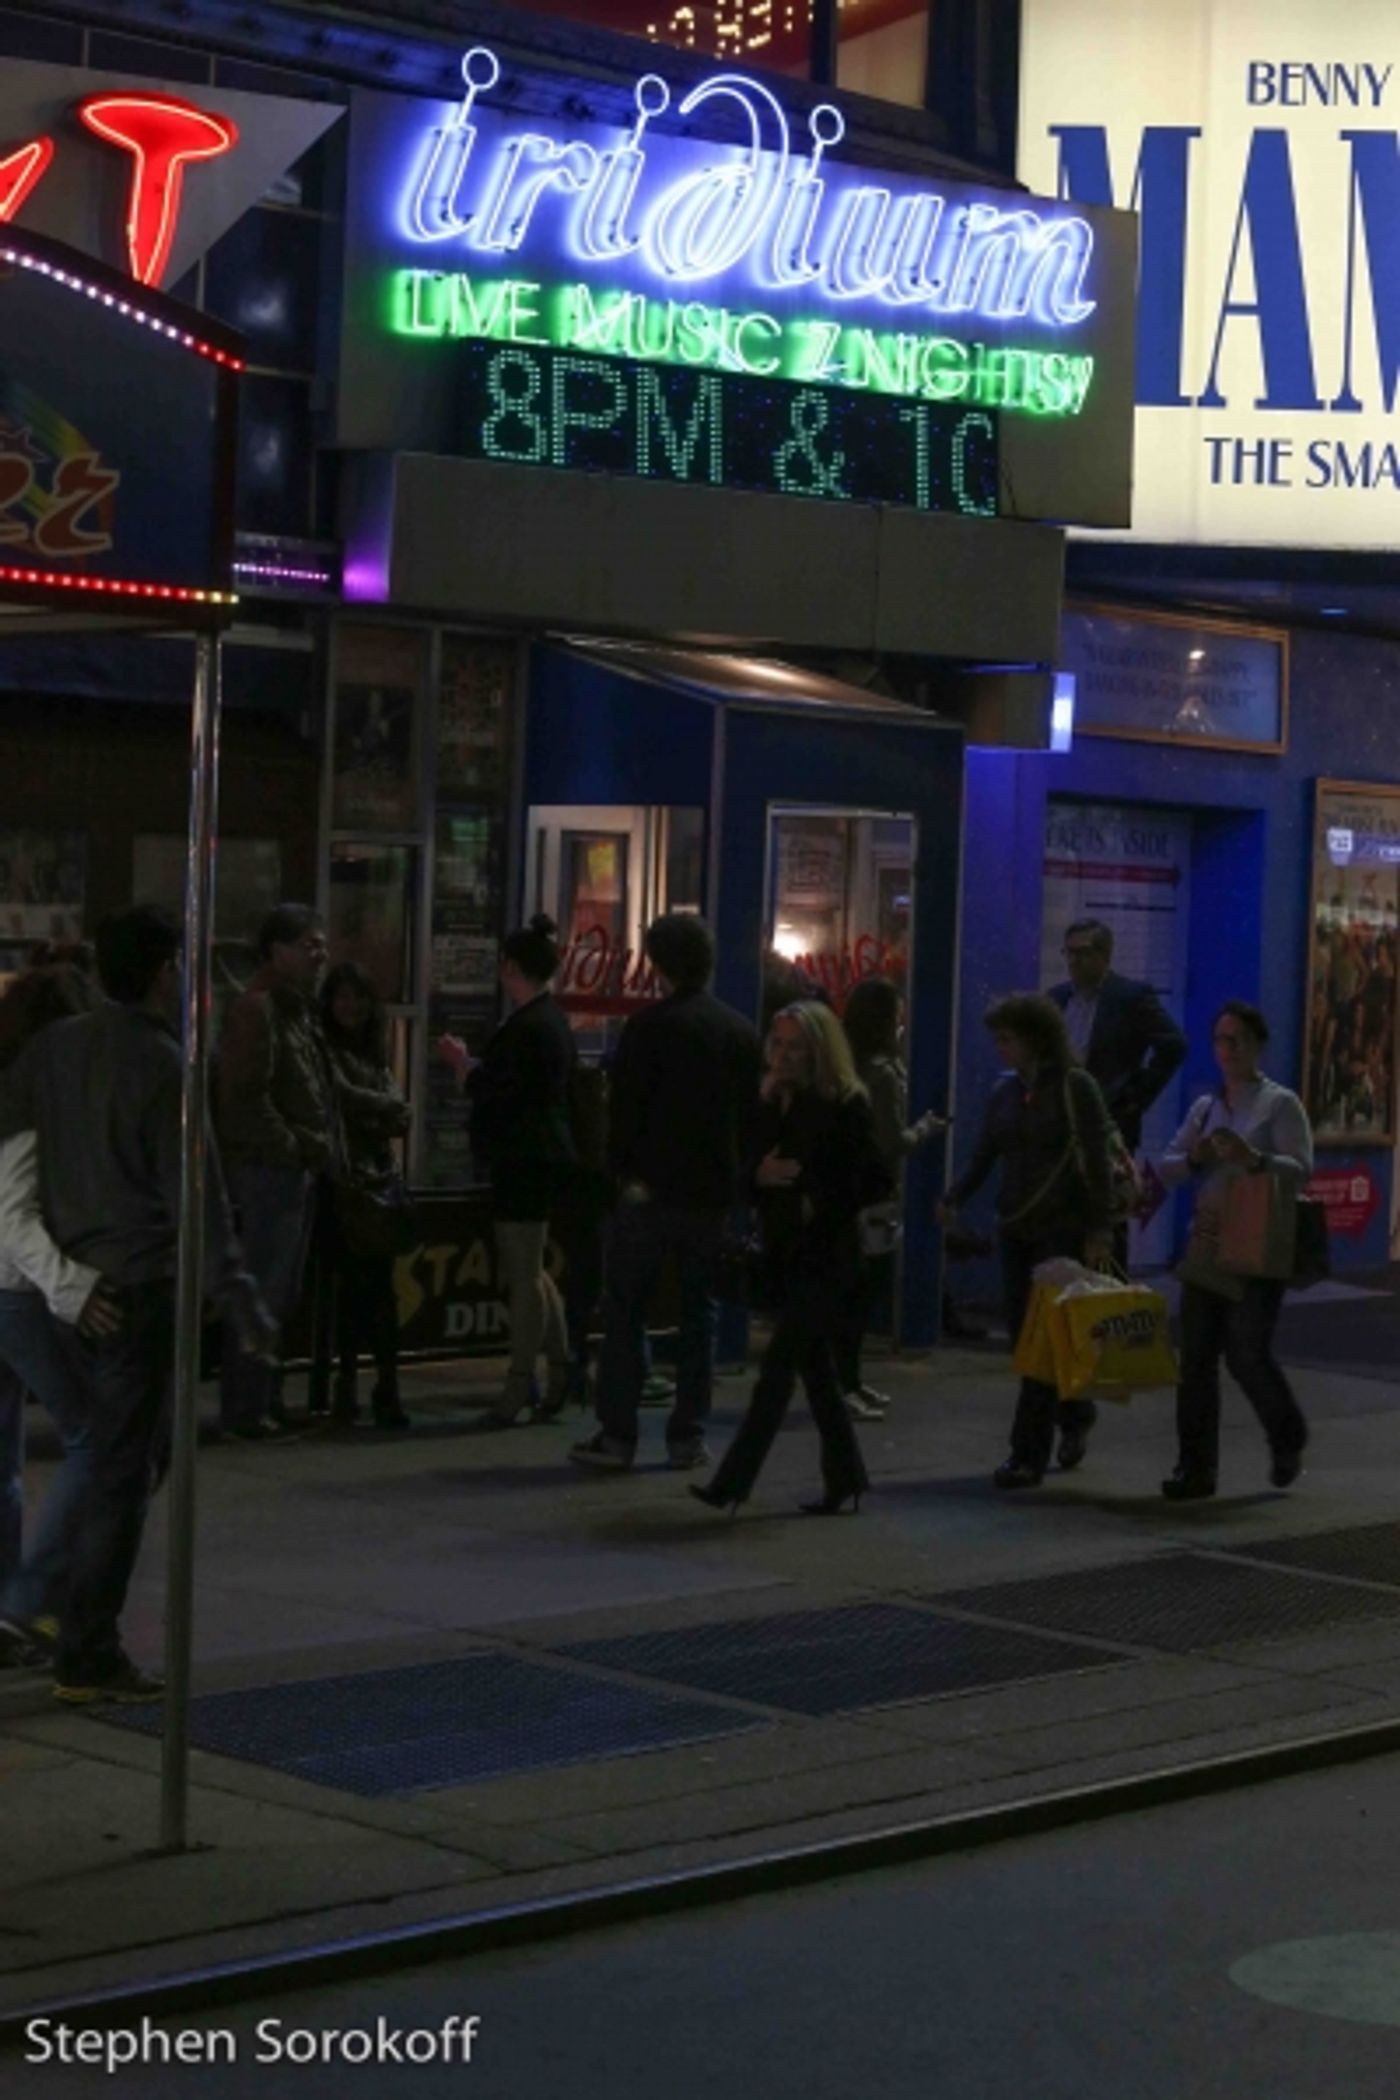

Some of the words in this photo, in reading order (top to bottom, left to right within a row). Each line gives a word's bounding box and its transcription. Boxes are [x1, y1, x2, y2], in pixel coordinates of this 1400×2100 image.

[1246, 60, 1393, 107] BENNY
[394, 47, 1098, 326] iridium
[396, 266, 549, 346] LIVE
[558, 282, 783, 376] MUSIC
[482, 349, 723, 485] 8PM
[771, 387, 853, 500] &
[1203, 436, 1293, 487] THE
